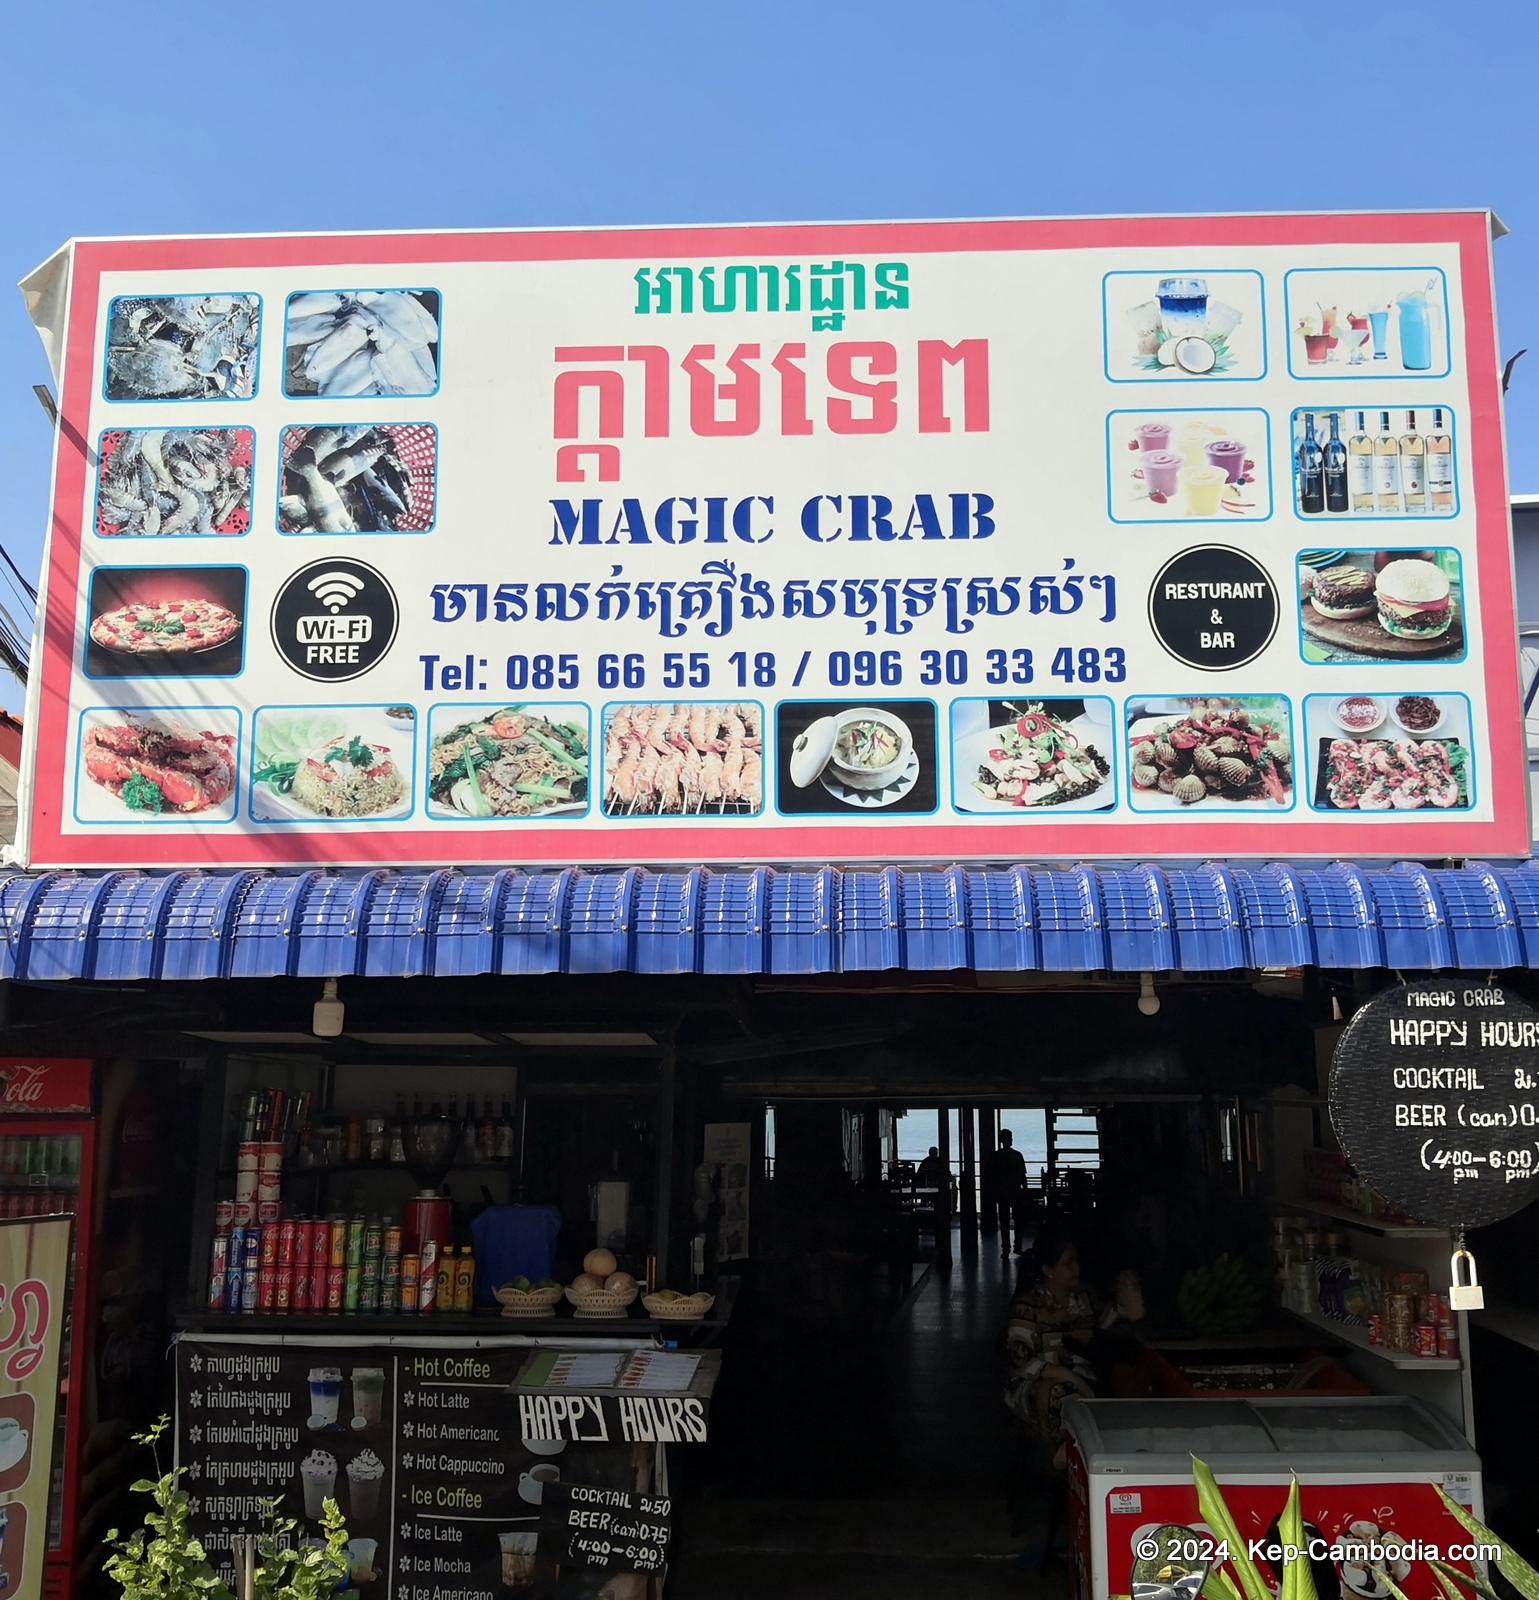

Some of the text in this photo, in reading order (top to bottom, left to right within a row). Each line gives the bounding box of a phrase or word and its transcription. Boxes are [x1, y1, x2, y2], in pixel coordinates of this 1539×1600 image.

[548, 491, 996, 546] MAGIC CRAB
[1165, 582, 1266, 600] RESTURANT
[1210, 608, 1223, 625] &
[302, 619, 368, 640] Wi-Fi
[1200, 631, 1236, 649] BAR
[306, 645, 360, 664] FREE
[419, 654, 488, 691] Tel:
[506, 654, 579, 690] 085
[597, 653, 645, 690] 66
[663, 652, 711, 689] 55
[727, 651, 776, 688] 18
[828, 649, 903, 687] 096
[920, 649, 968, 685] 30
[986, 648, 1034, 685] 33
[1050, 646, 1127, 684] 483
[1407, 988, 1506, 1007] MAGIC CRAB
[1389, 1019, 1468, 1047] HAPPY
[1393, 1067, 1485, 1091] COCKTAIL
[1395, 1104, 1447, 1127] BEER
[1453, 1167, 1531, 1184] pm pm
[414, 1357, 440, 1377] Hot
[443, 1357, 491, 1379] Coffee
[418, 1391, 470, 1409] Hot Latte
[518, 1395, 708, 1443] HAPPY HOURS
[417, 1422, 438, 1439] Hot
[416, 1453, 505, 1476] Hot Cappuccino
[411, 1484, 433, 1505] Ice
[436, 1486, 483, 1509] Coffee
[571, 1487, 632, 1509] COCKTAIL
[568, 1509, 611, 1530] BEER
[414, 1523, 463, 1542] Ice Latte
[413, 1555, 472, 1574] Ice Mocha
[587, 1554, 655, 1570] pm pm
[412, 1584, 494, 1600] Ice Americano
